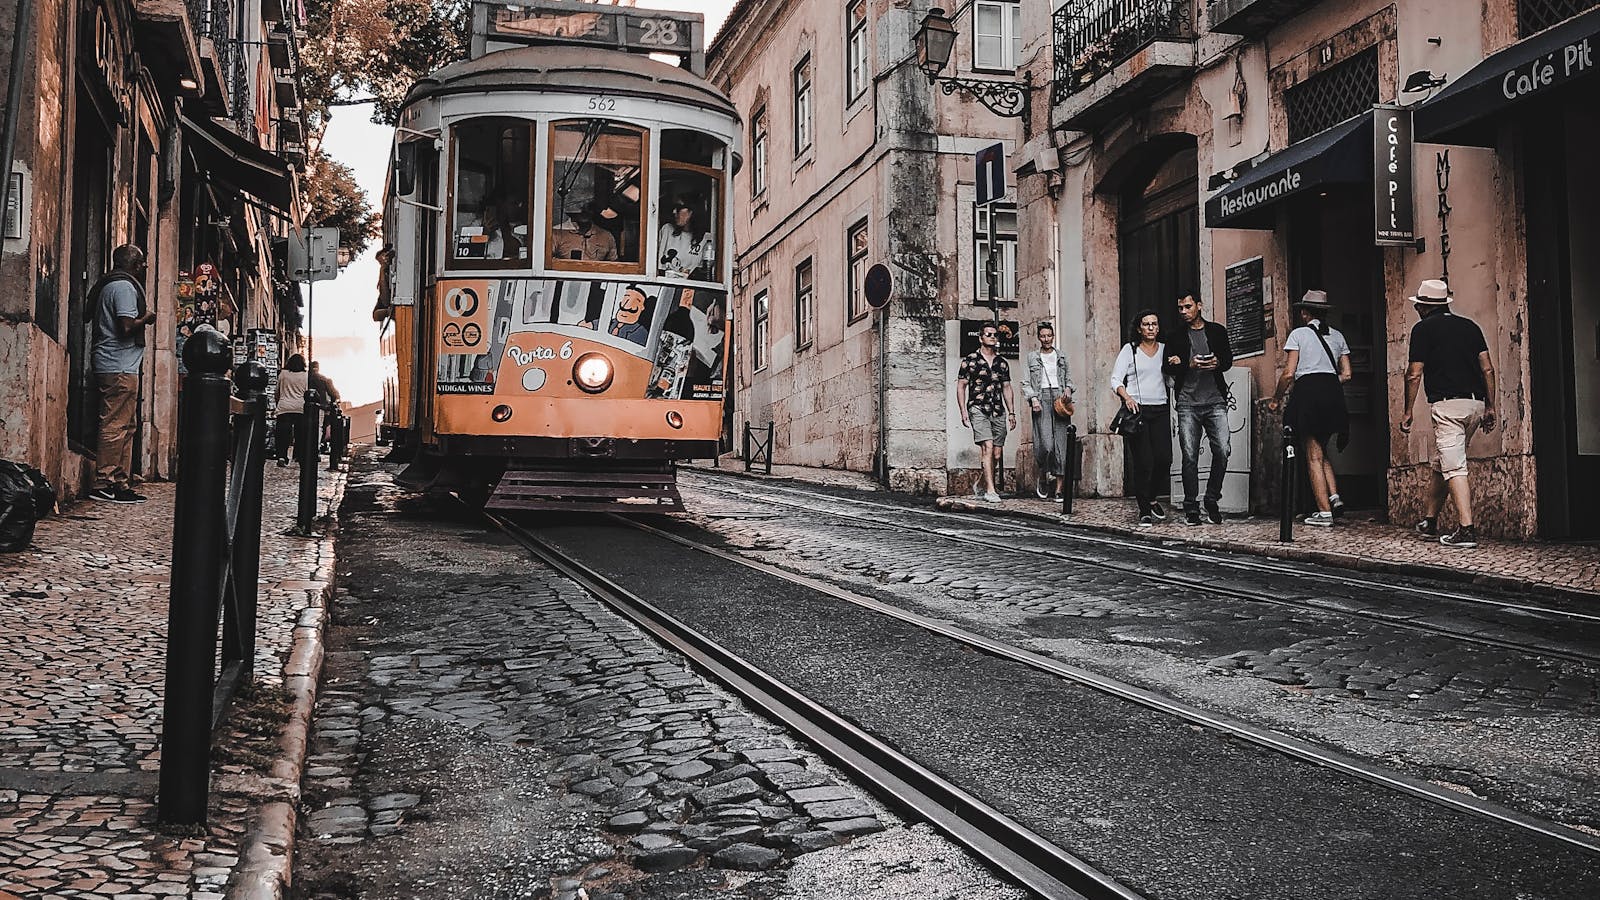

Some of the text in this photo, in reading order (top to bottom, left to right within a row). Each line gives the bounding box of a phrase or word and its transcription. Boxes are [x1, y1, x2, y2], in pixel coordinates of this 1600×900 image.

[640, 19, 678, 45] 28
[1322, 46, 1331, 64] 19
[1503, 38, 1593, 99] Café Pit
[588, 97, 616, 111] 562
[1387, 117, 1398, 173] Café
[1220, 168, 1301, 217] Restaurante
[458, 247, 469, 257] 10
[507, 340, 573, 367] Porta 6
[437, 384, 466, 392] VIDIGAL
